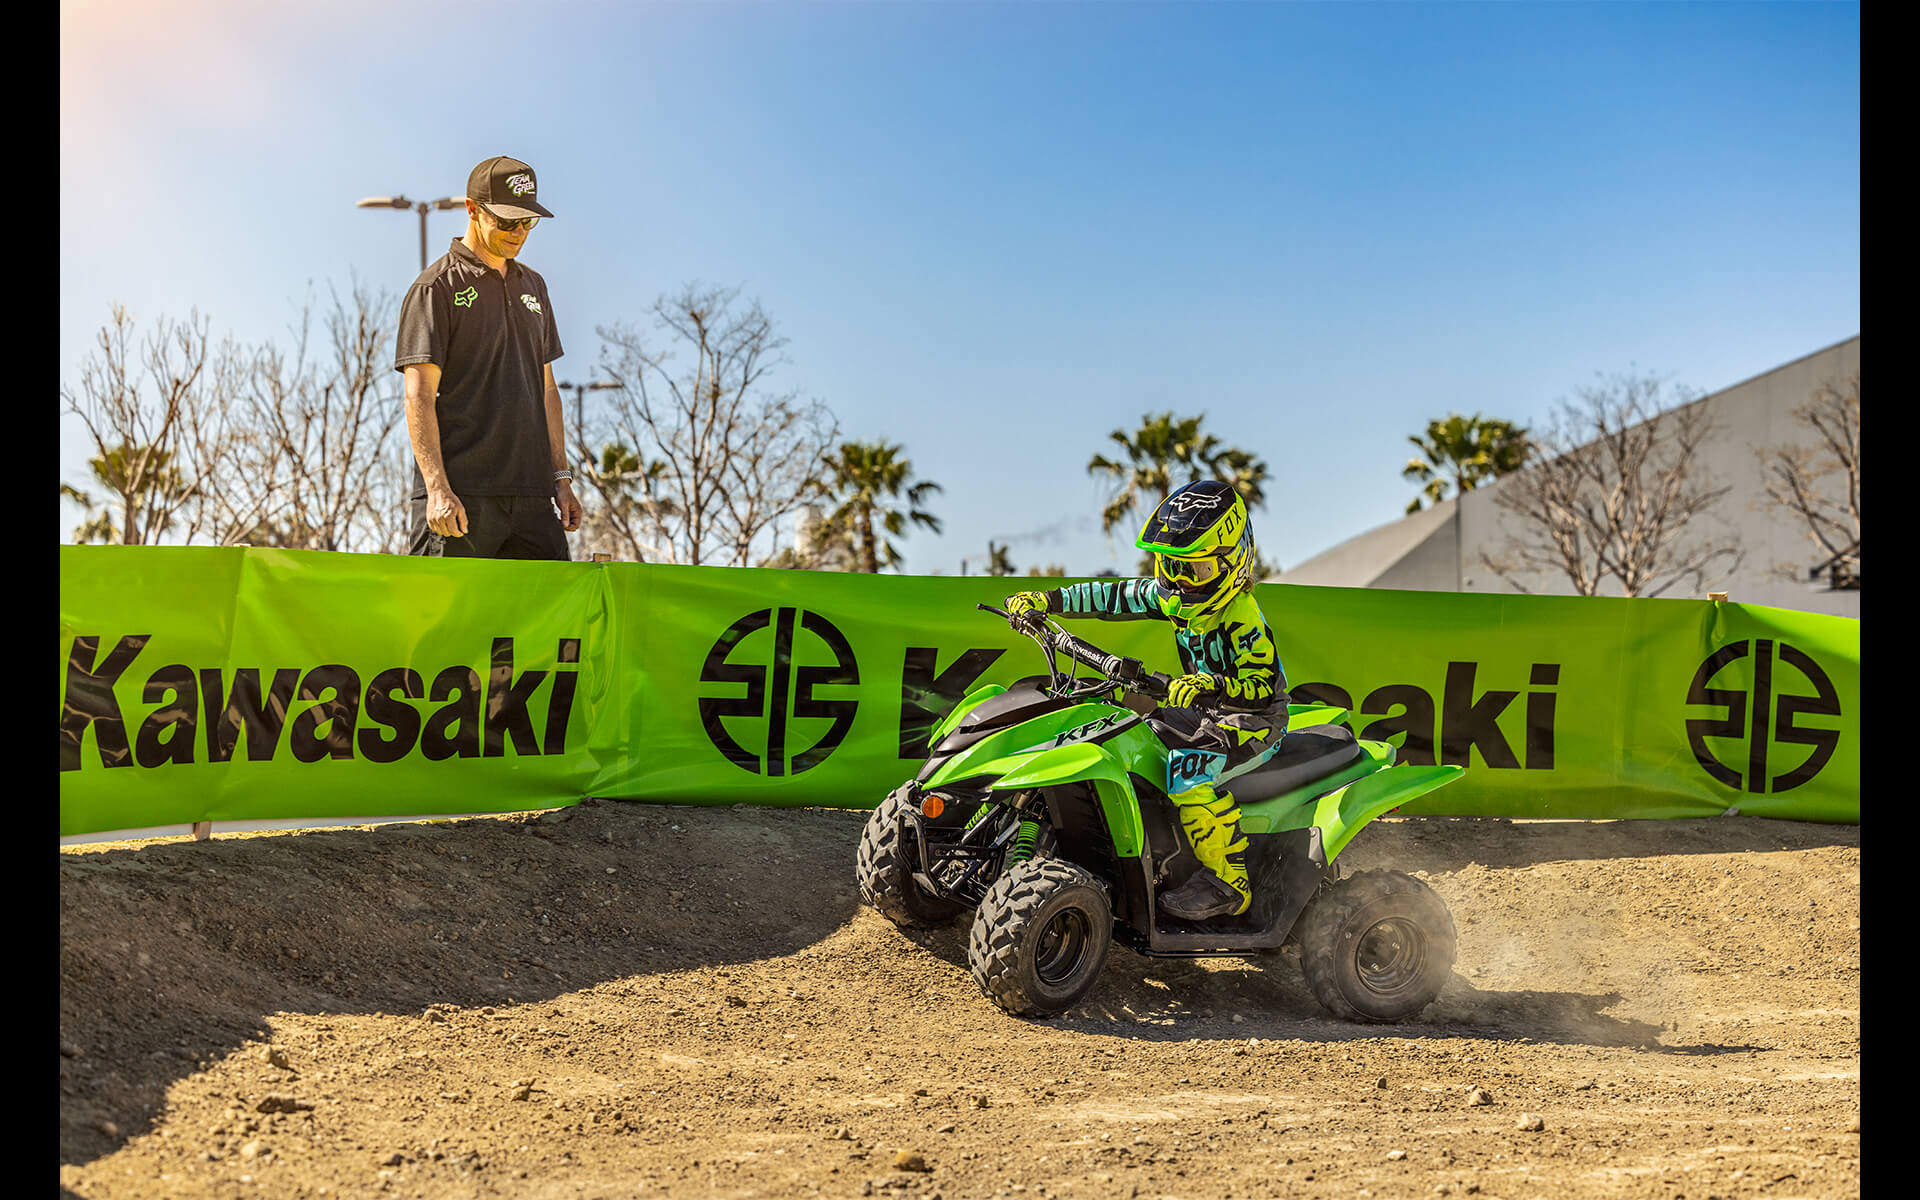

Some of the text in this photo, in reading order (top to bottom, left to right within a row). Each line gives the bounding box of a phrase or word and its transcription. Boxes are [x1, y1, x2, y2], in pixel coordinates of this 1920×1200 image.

[1217, 505, 1241, 545] FOX
[60, 634, 581, 771] Kawasaki
[1054, 711, 1120, 748] KFX
[1169, 753, 1217, 790] FOX
